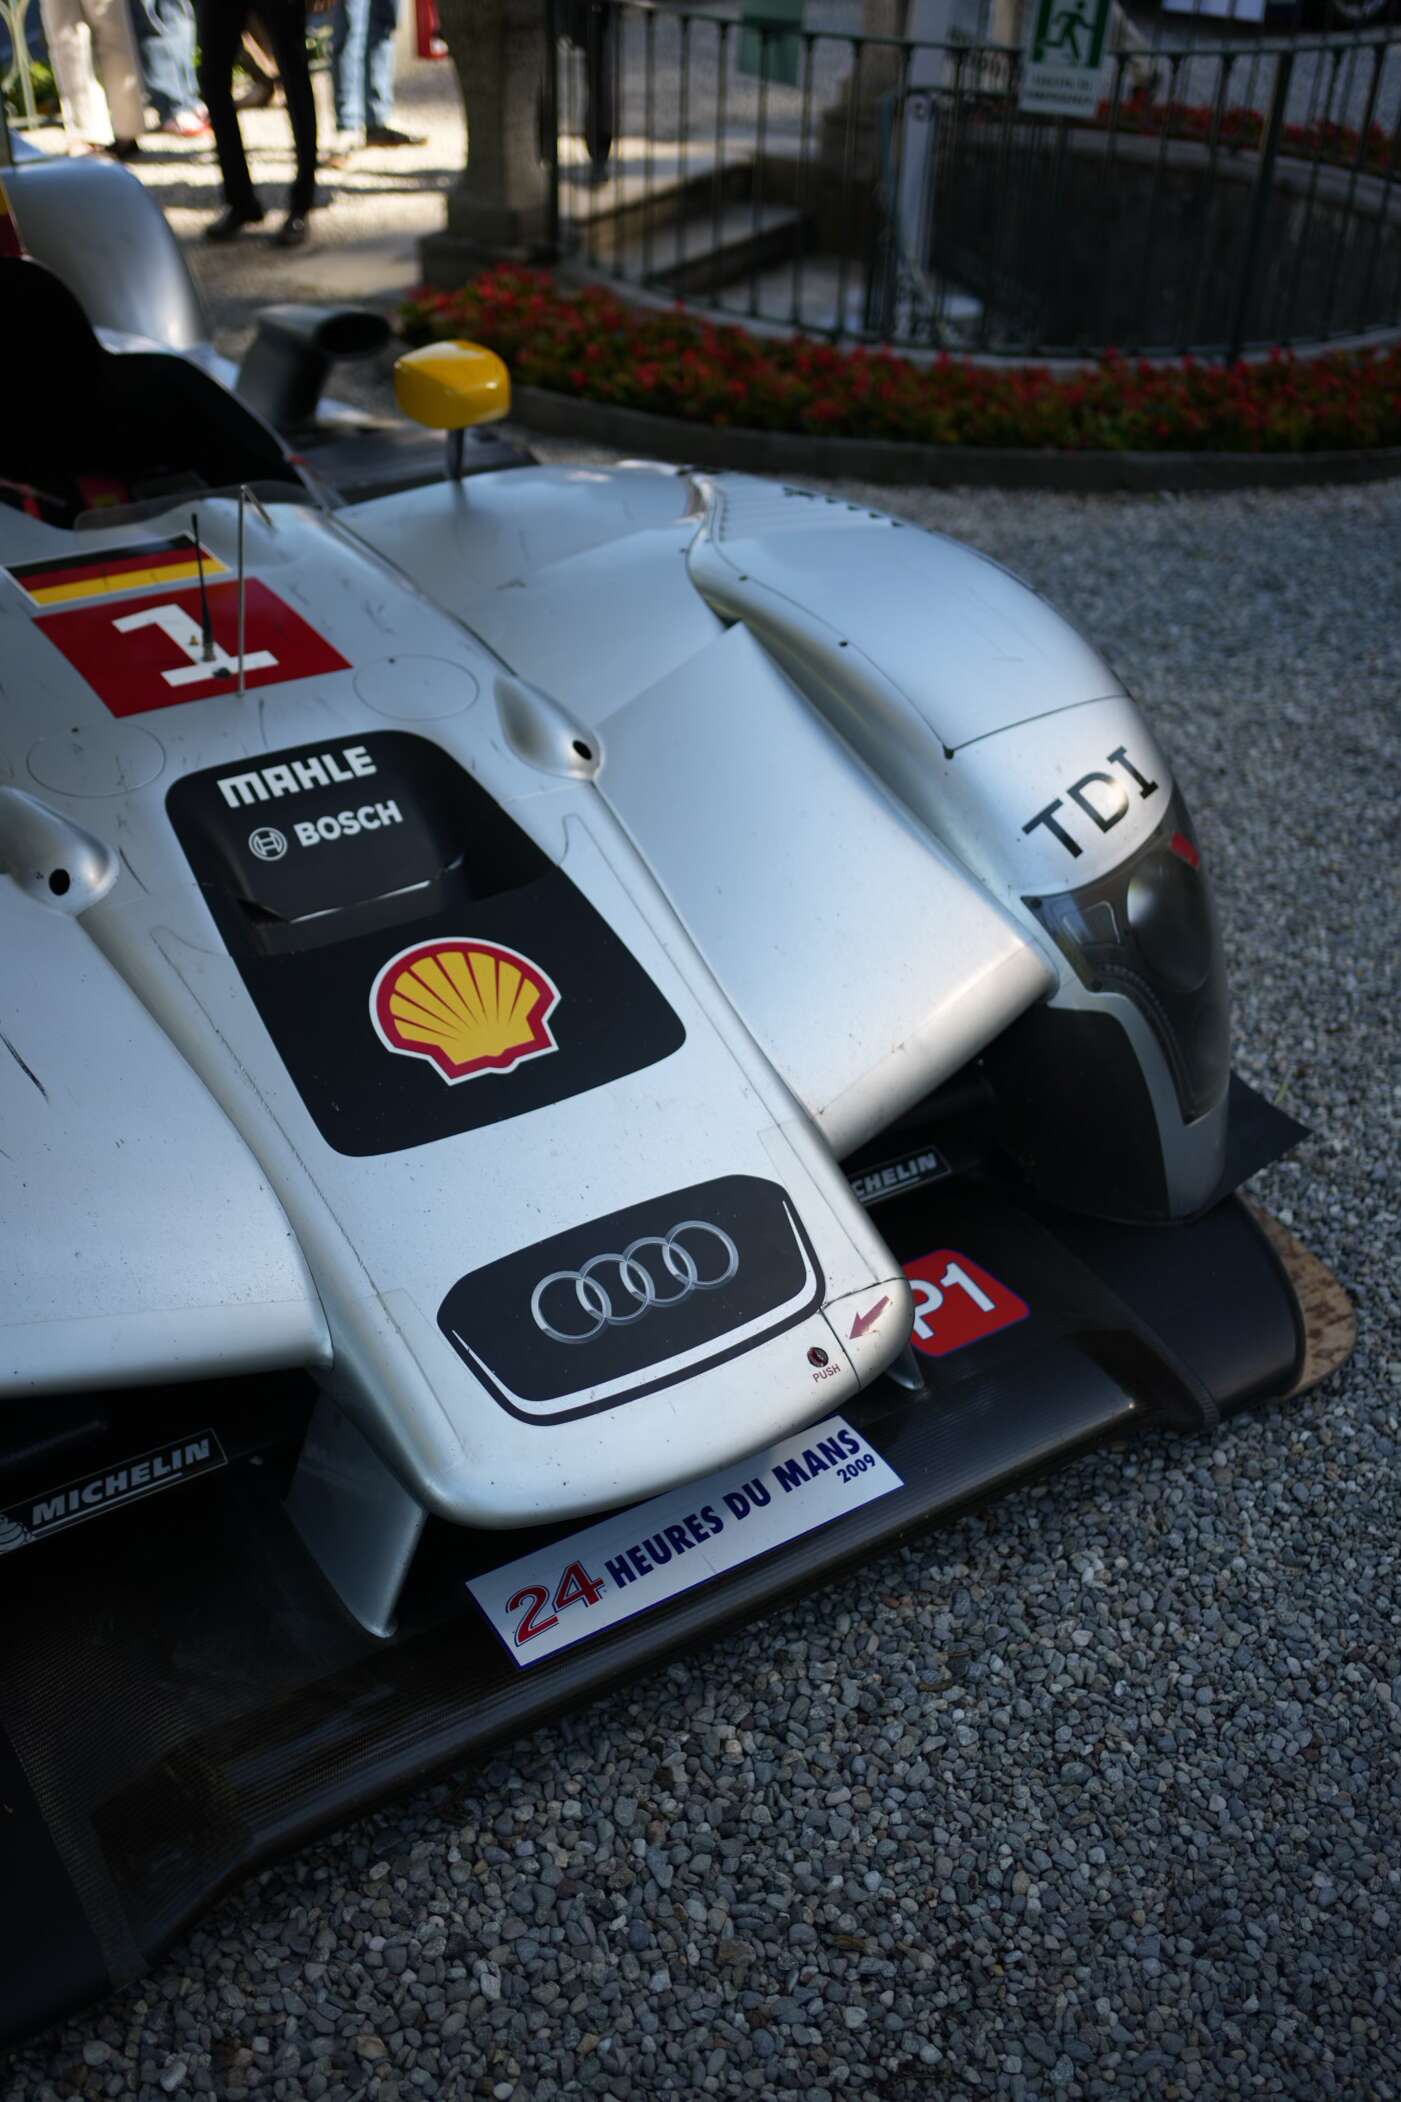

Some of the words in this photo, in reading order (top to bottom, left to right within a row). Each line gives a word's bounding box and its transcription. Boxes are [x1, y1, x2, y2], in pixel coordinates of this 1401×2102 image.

[112, 603, 279, 688] 1
[216, 745, 377, 808] MAHLE
[1022, 745, 1159, 859] TDI
[293, 800, 403, 847] BOSCH
[851, 1152, 937, 1197] CHELIN
[812, 1363, 841, 1383] PUSH
[32, 1438, 210, 1525] MICHELIN
[836, 1453, 876, 1484] 2009
[505, 1560, 605, 1648] 24
[604, 1505, 725, 1589] HEURES
[723, 1477, 772, 1521] DU
[771, 1429, 861, 1493] MANS
